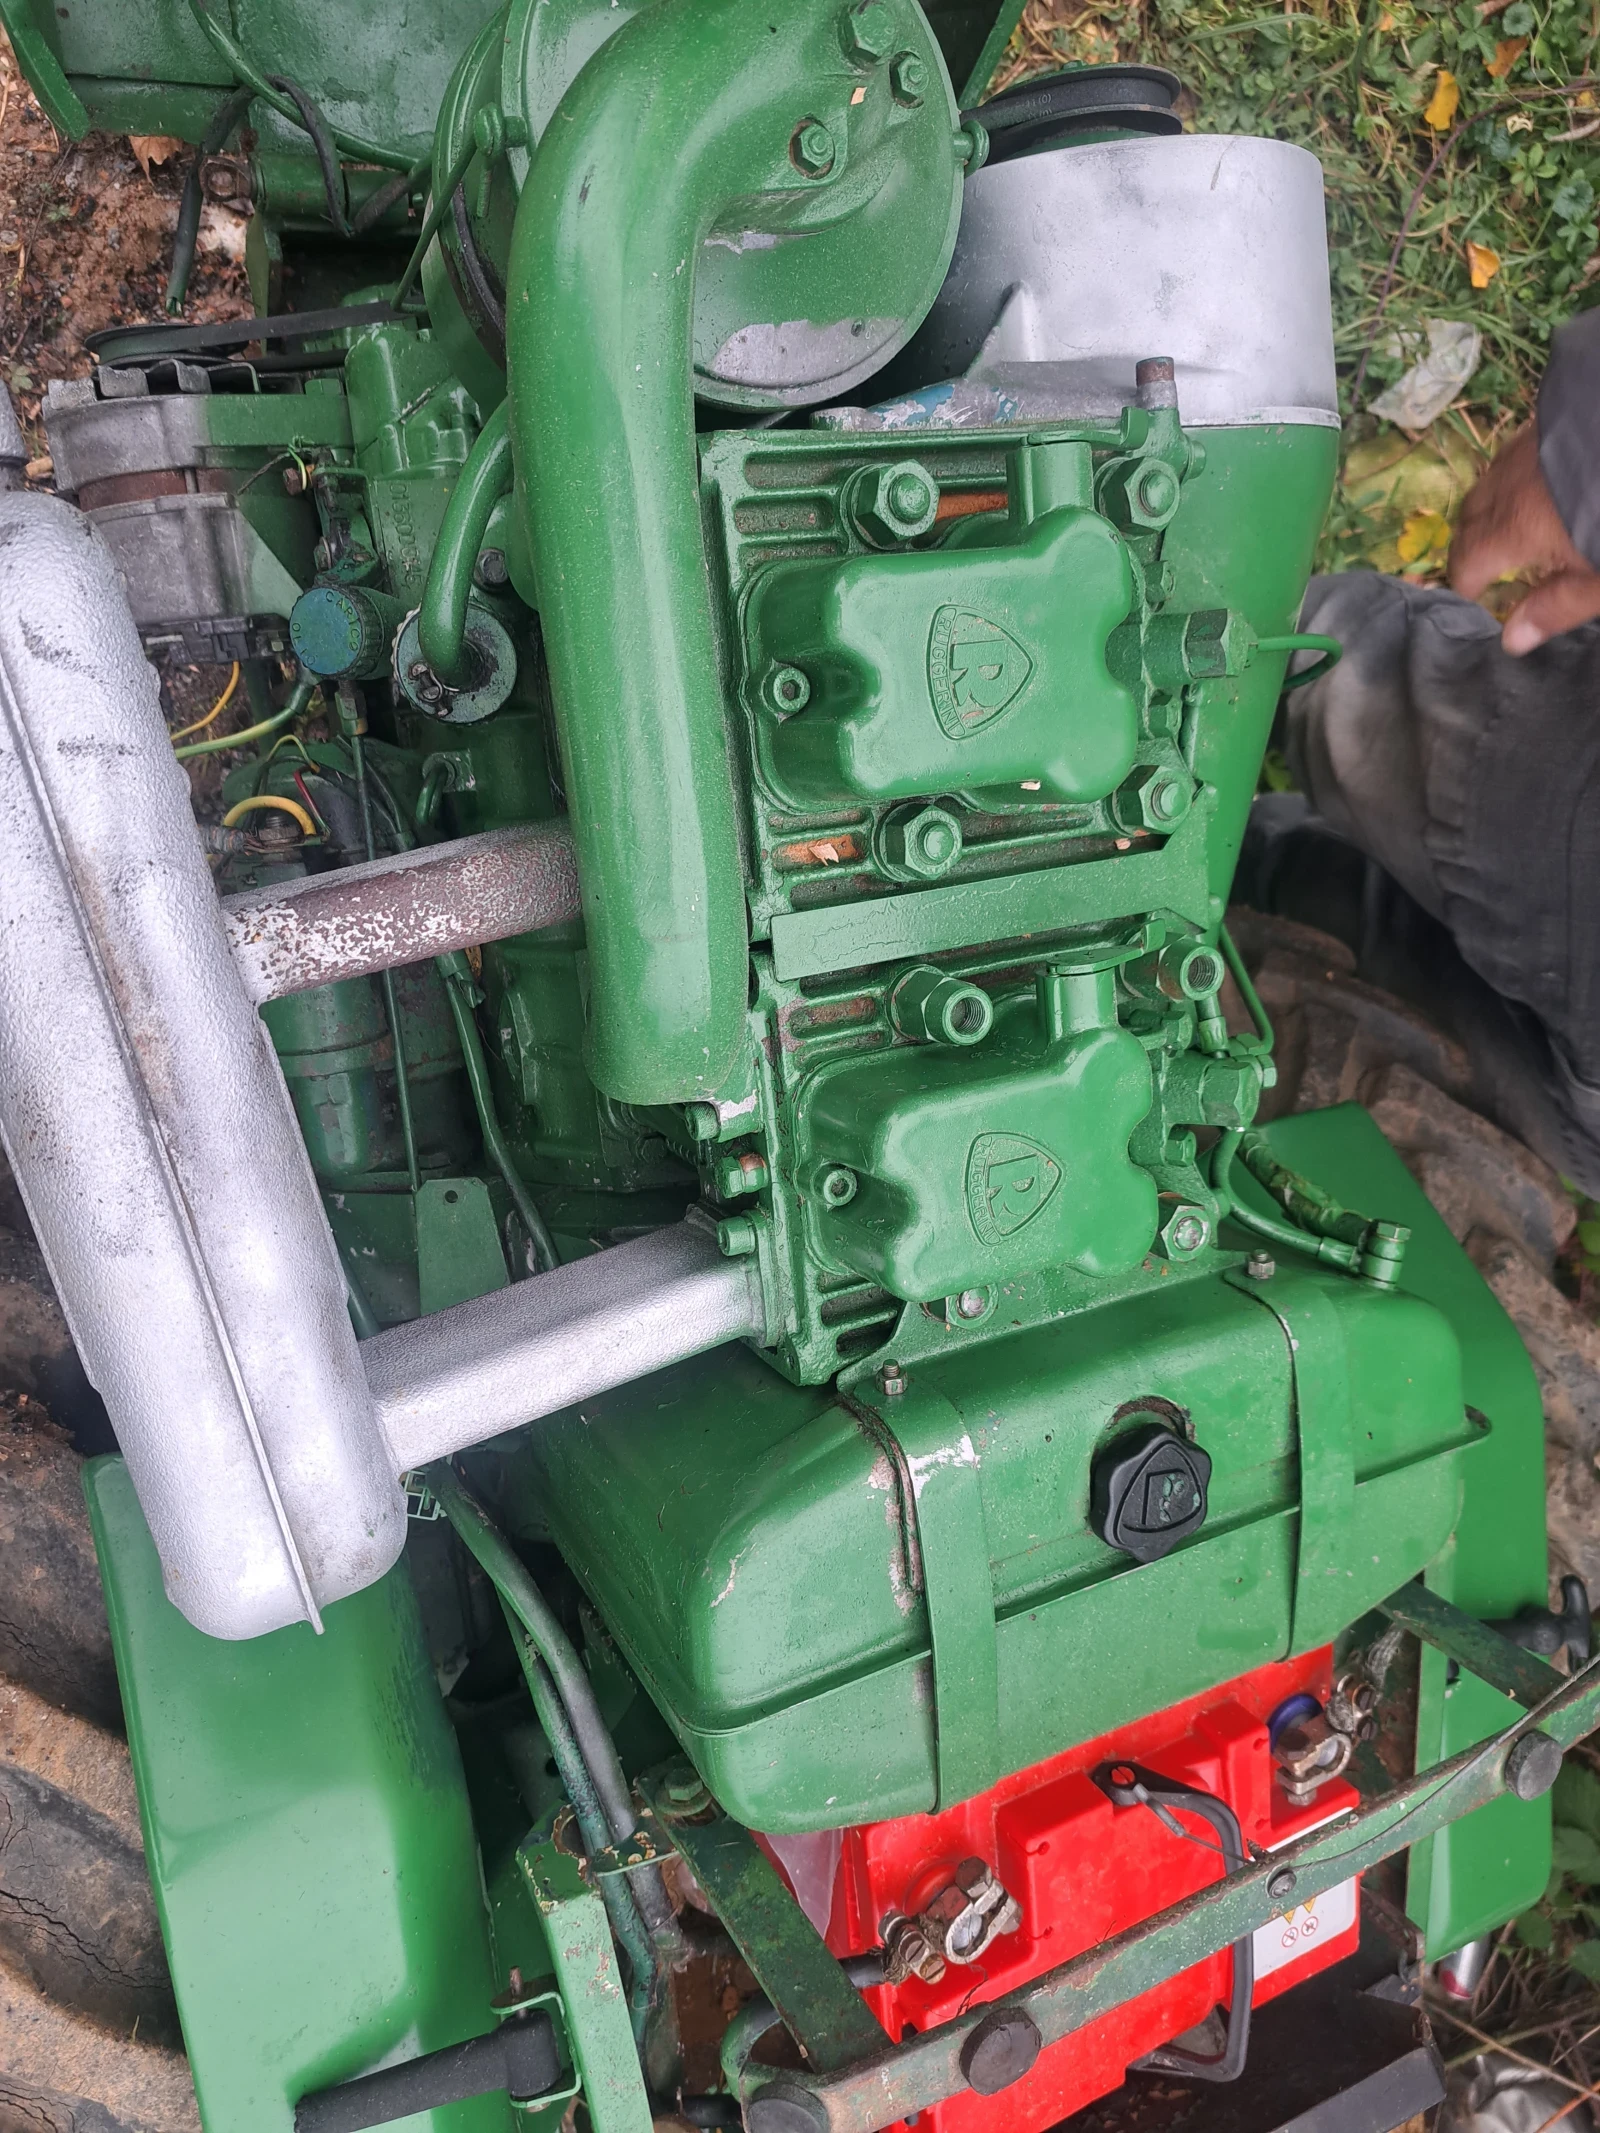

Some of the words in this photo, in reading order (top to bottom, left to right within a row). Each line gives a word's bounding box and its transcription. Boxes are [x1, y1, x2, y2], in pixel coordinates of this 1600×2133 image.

[325, 591, 360, 652] CARICO
[931, 617, 960, 732] RUGGERINI
[948, 638, 1010, 708] R
[971, 1141, 996, 1241] RUGGERINI
